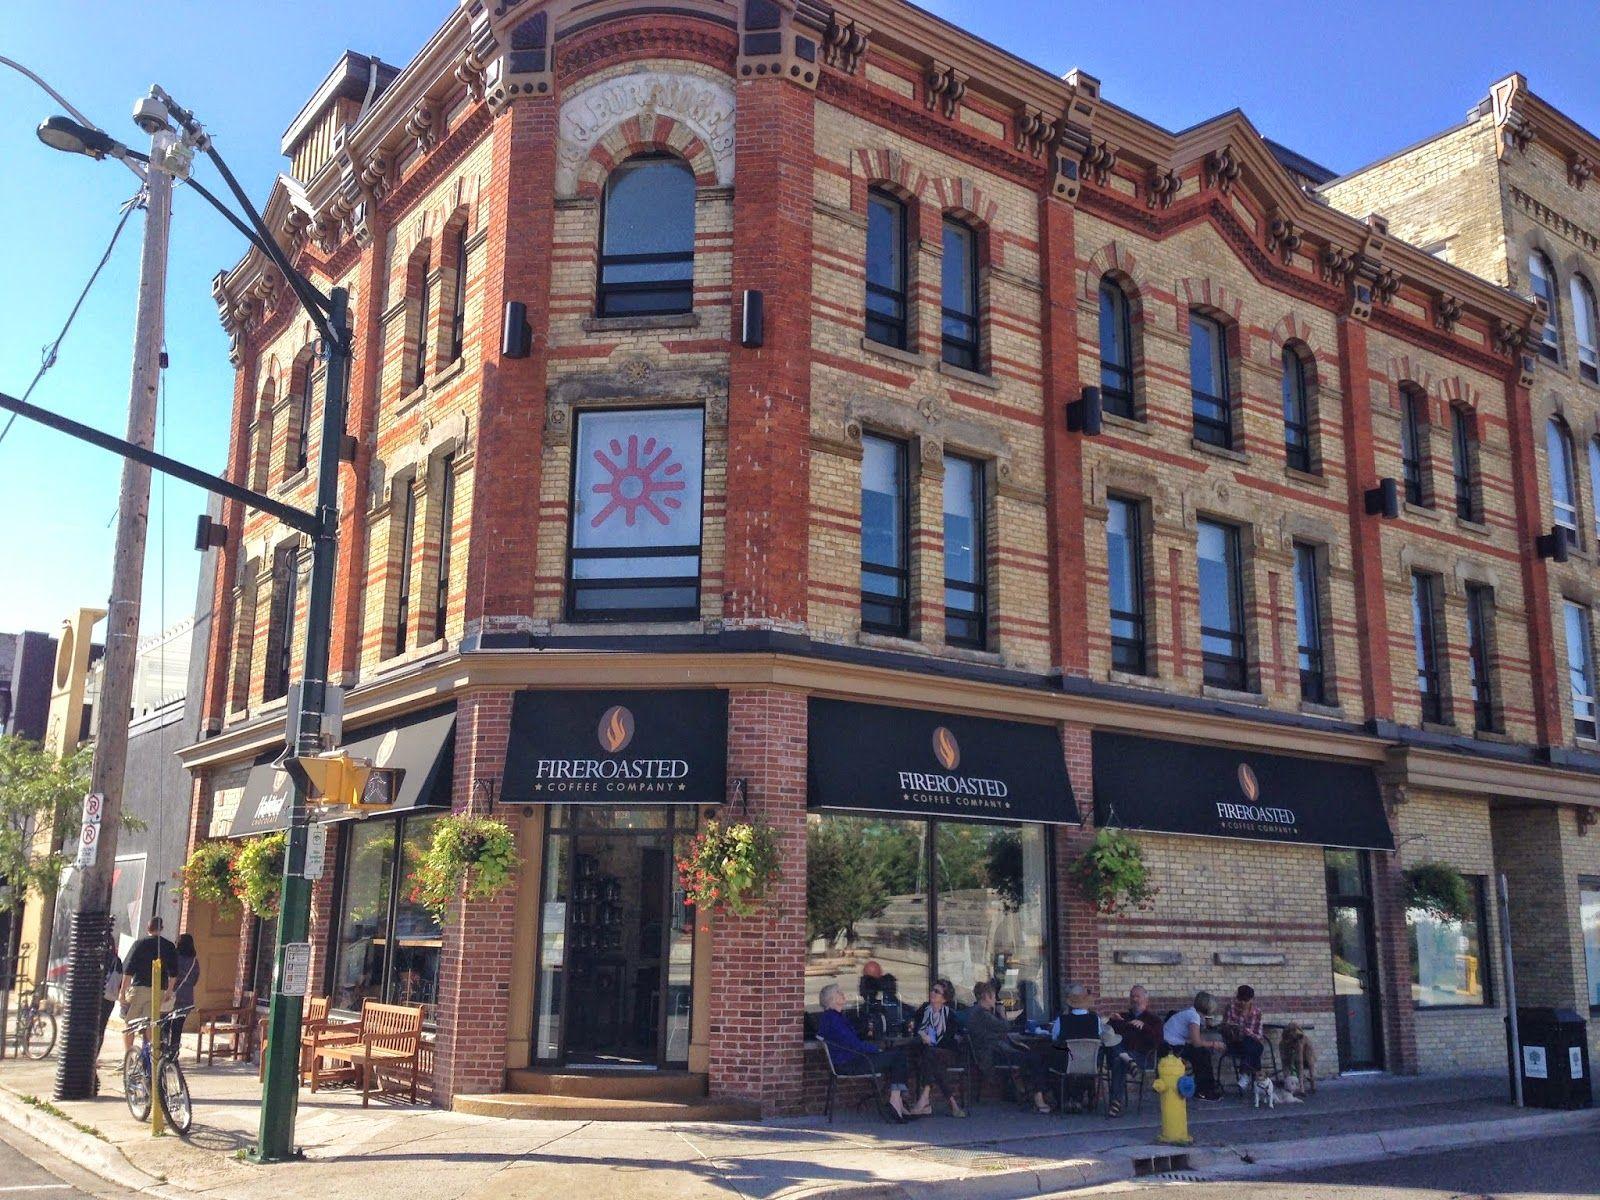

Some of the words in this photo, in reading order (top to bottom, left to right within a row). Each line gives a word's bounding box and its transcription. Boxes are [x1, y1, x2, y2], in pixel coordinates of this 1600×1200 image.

[535, 759, 689, 779] FIREROASTED
[547, 782, 598, 792] COFFEE
[606, 782, 674, 792] COMPANY
[898, 771, 1008, 798] FIREROASTED
[912, 793, 951, 805] COFFEE
[955, 797, 1002, 809] COMPANY
[1216, 802, 1295, 824] FIREROASTED
[1228, 821, 1255, 831] COFFEE
[1258, 824, 1292, 834] COMPANY
